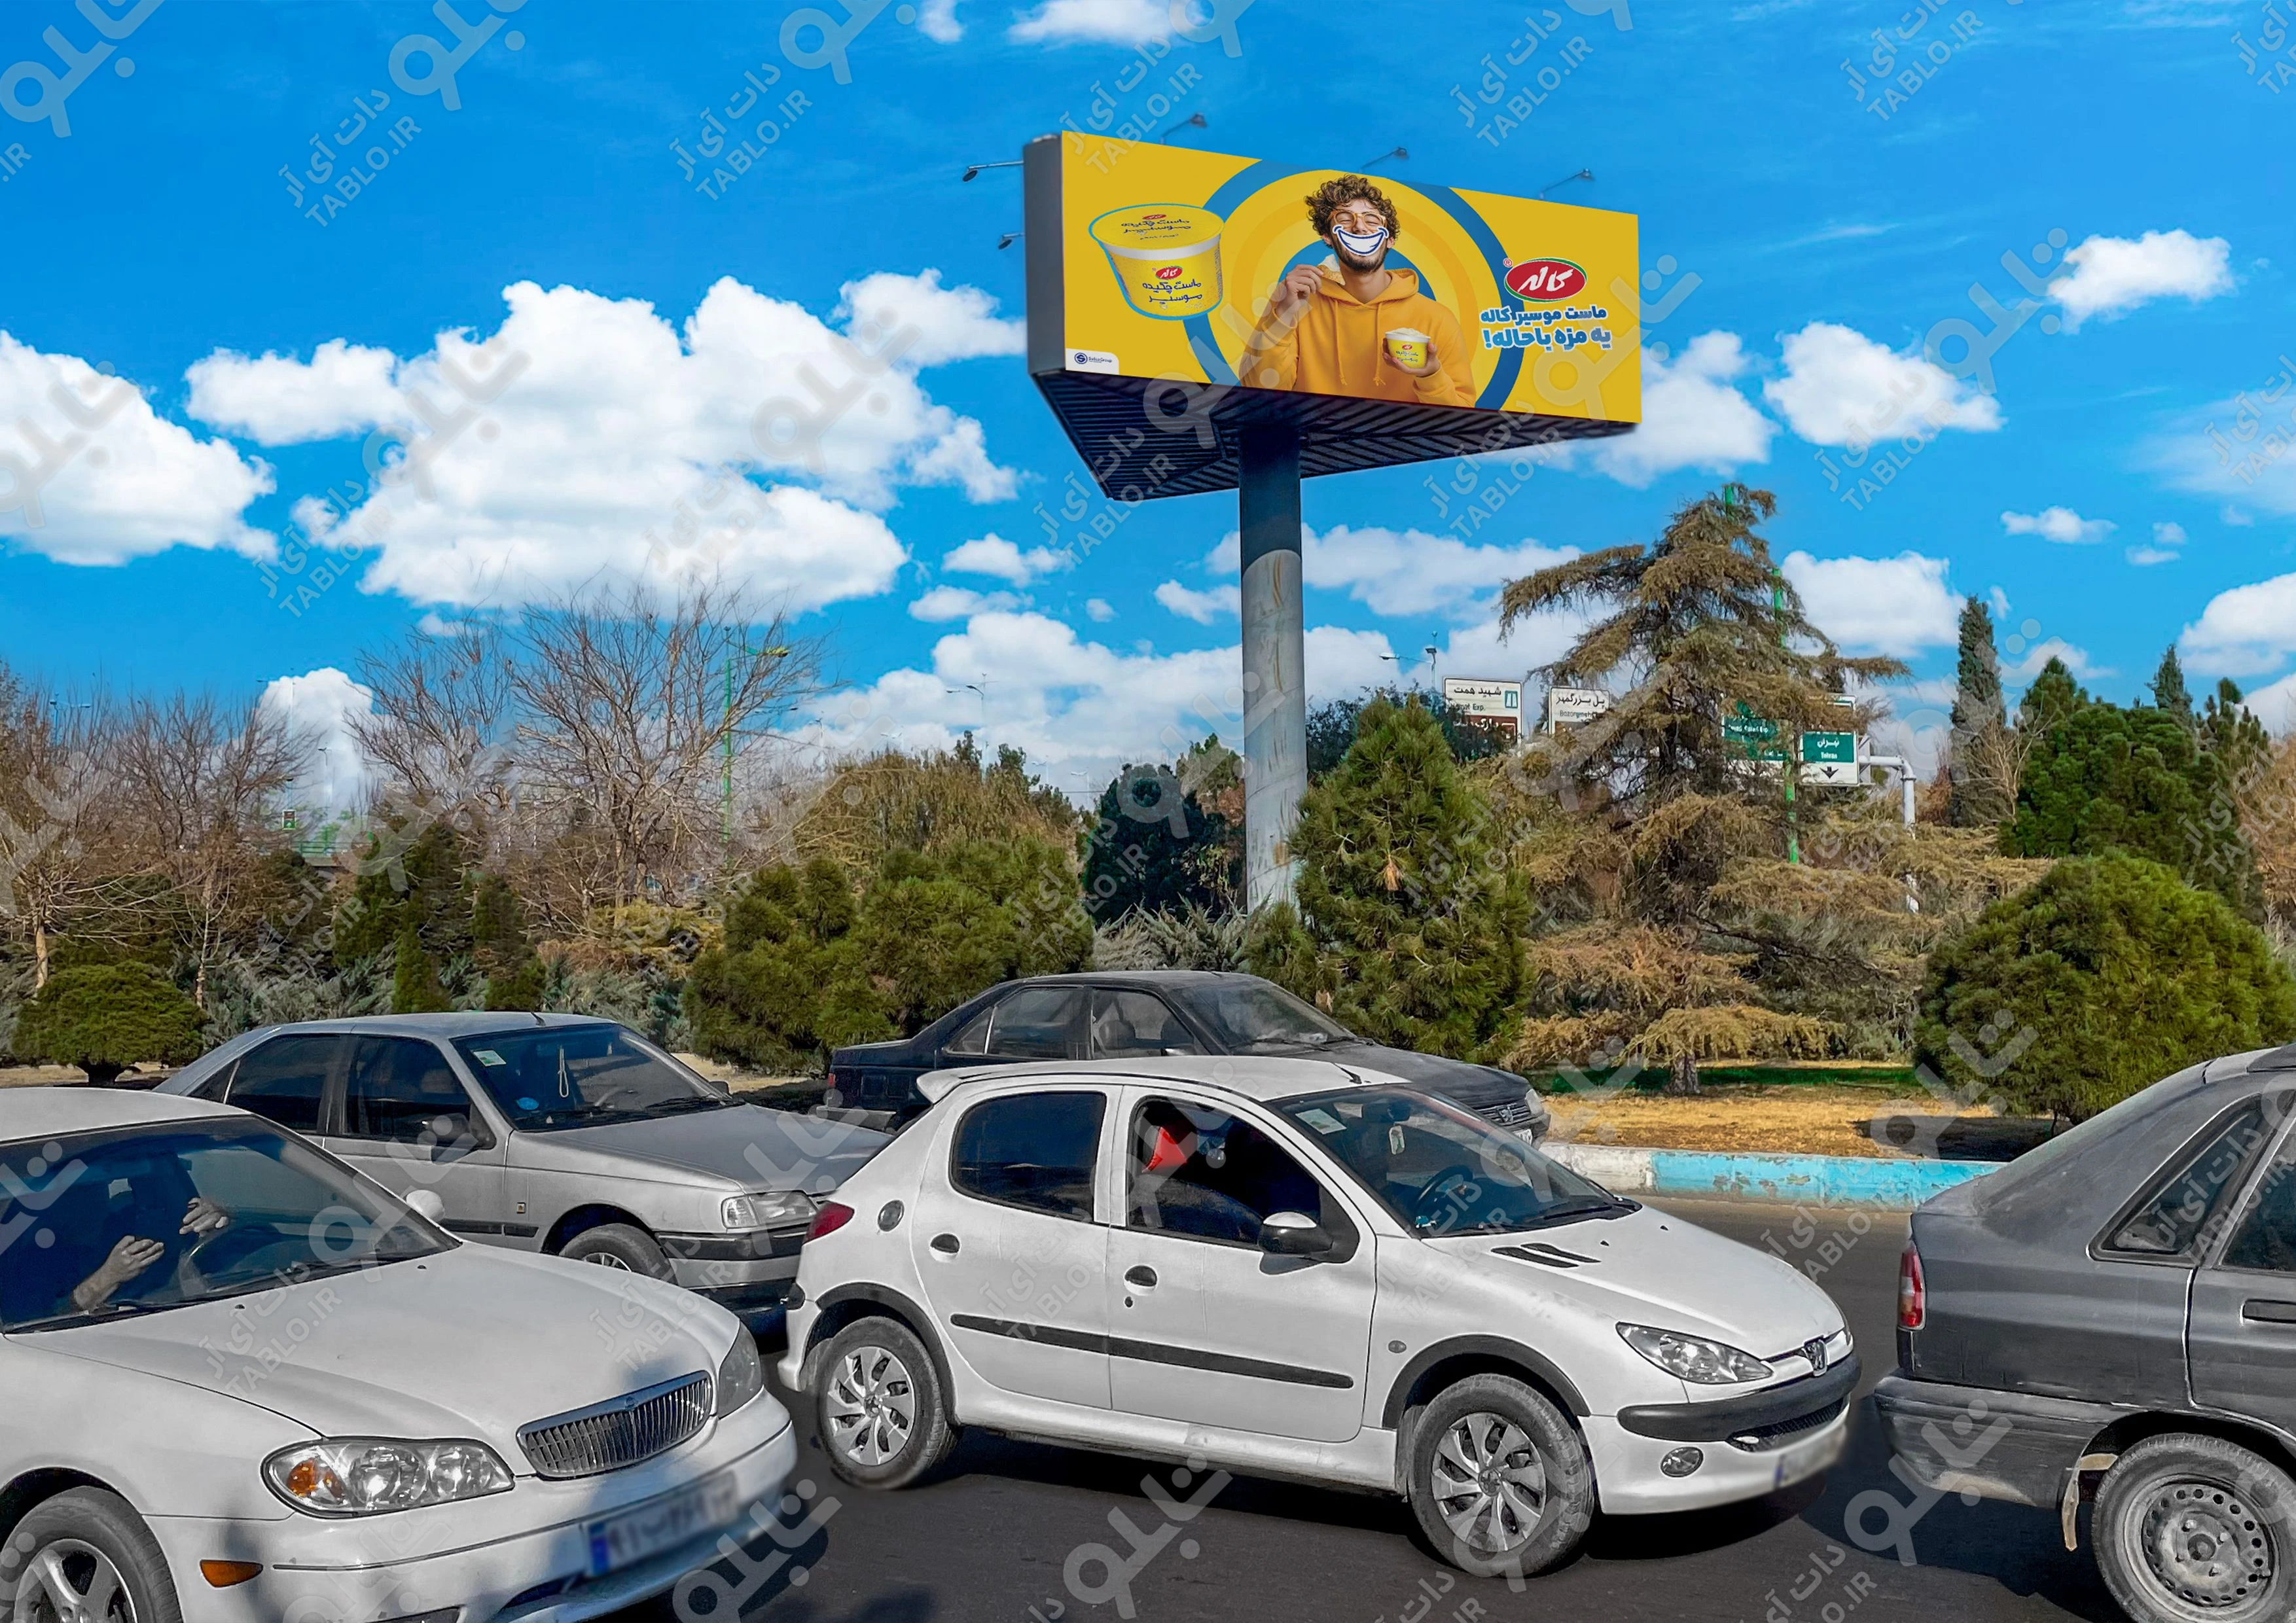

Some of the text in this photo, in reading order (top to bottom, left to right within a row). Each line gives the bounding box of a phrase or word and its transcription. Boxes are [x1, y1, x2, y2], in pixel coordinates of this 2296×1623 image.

[1142, 278, 1202, 294] ماست چکیده
[1149, 294, 1203, 305] موسیر
[1479, 304, 1607, 326] ماست موسیر کاله
[1554, 326, 1588, 351] مزه
[1590, 326, 1612, 350] یه
[1454, 687, 1501, 697] شهید همت
[1592, 694, 1605, 709] پل
[1817, 737, 1840, 748] تهران
